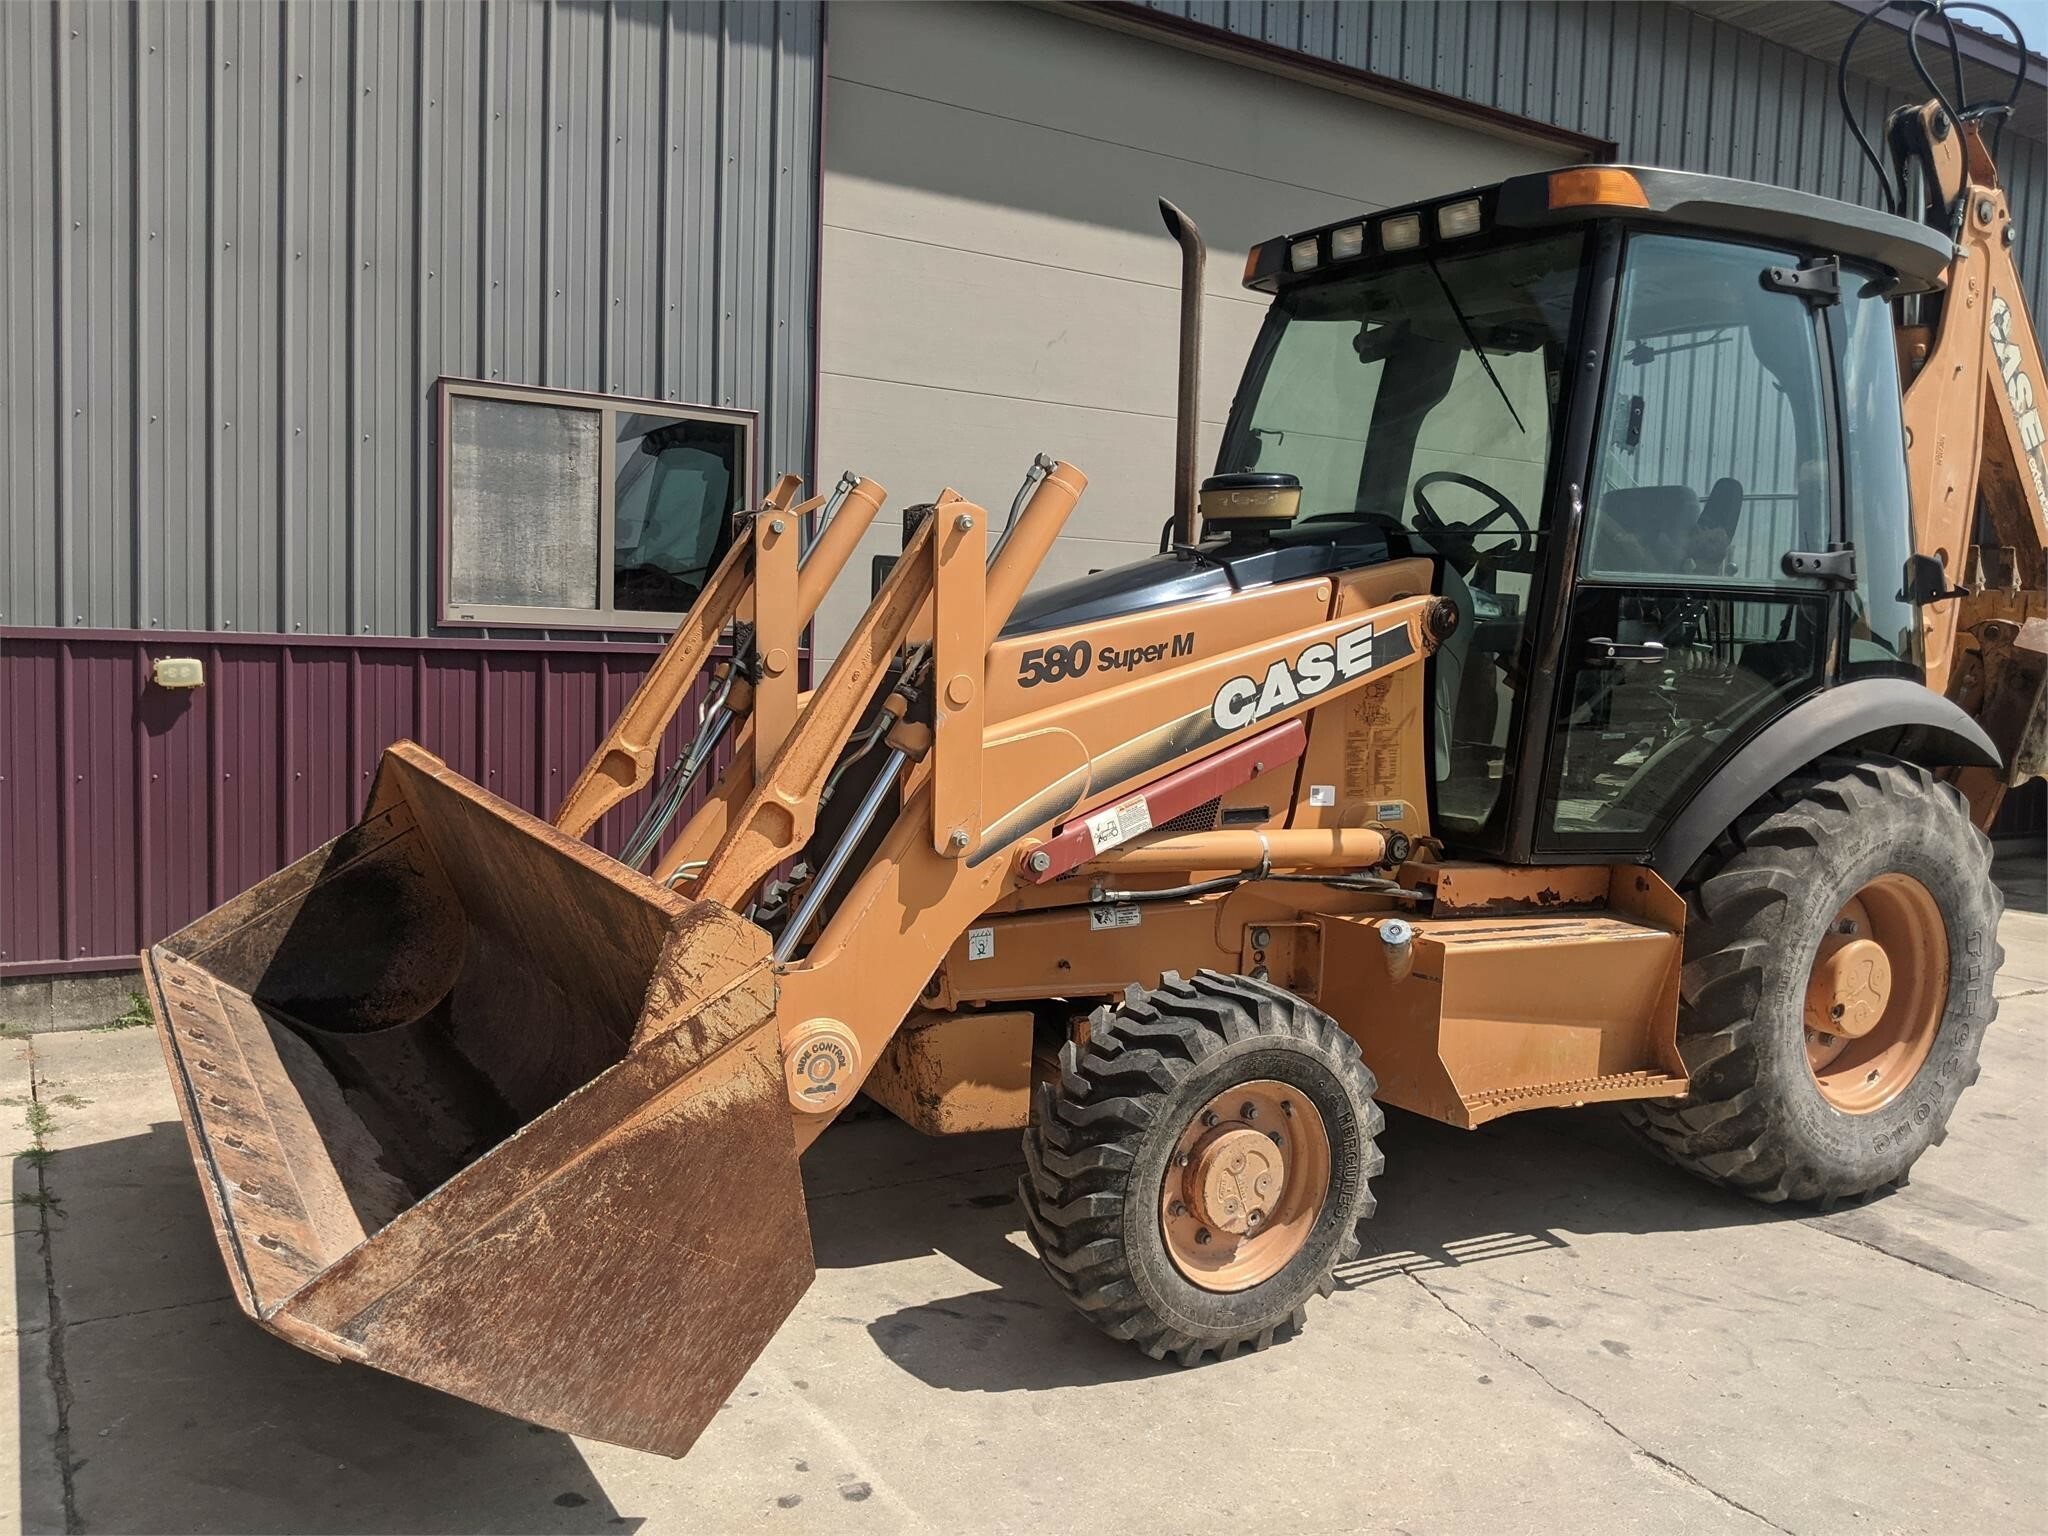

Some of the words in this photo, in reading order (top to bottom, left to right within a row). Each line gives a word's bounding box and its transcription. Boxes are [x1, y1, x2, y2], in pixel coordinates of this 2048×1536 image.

[1990, 297, 2047, 452] CASE
[1017, 640, 1092, 689] 580
[1097, 642, 1168, 672] Super
[1171, 632, 1194, 657] M
[1212, 624, 1374, 731] CASE
[798, 1050, 811, 1074] RIDE
[812, 1043, 846, 1069] CONTROL
[1873, 930, 1982, 1155] Firestone
[1336, 1111, 1358, 1219] HERCULES
